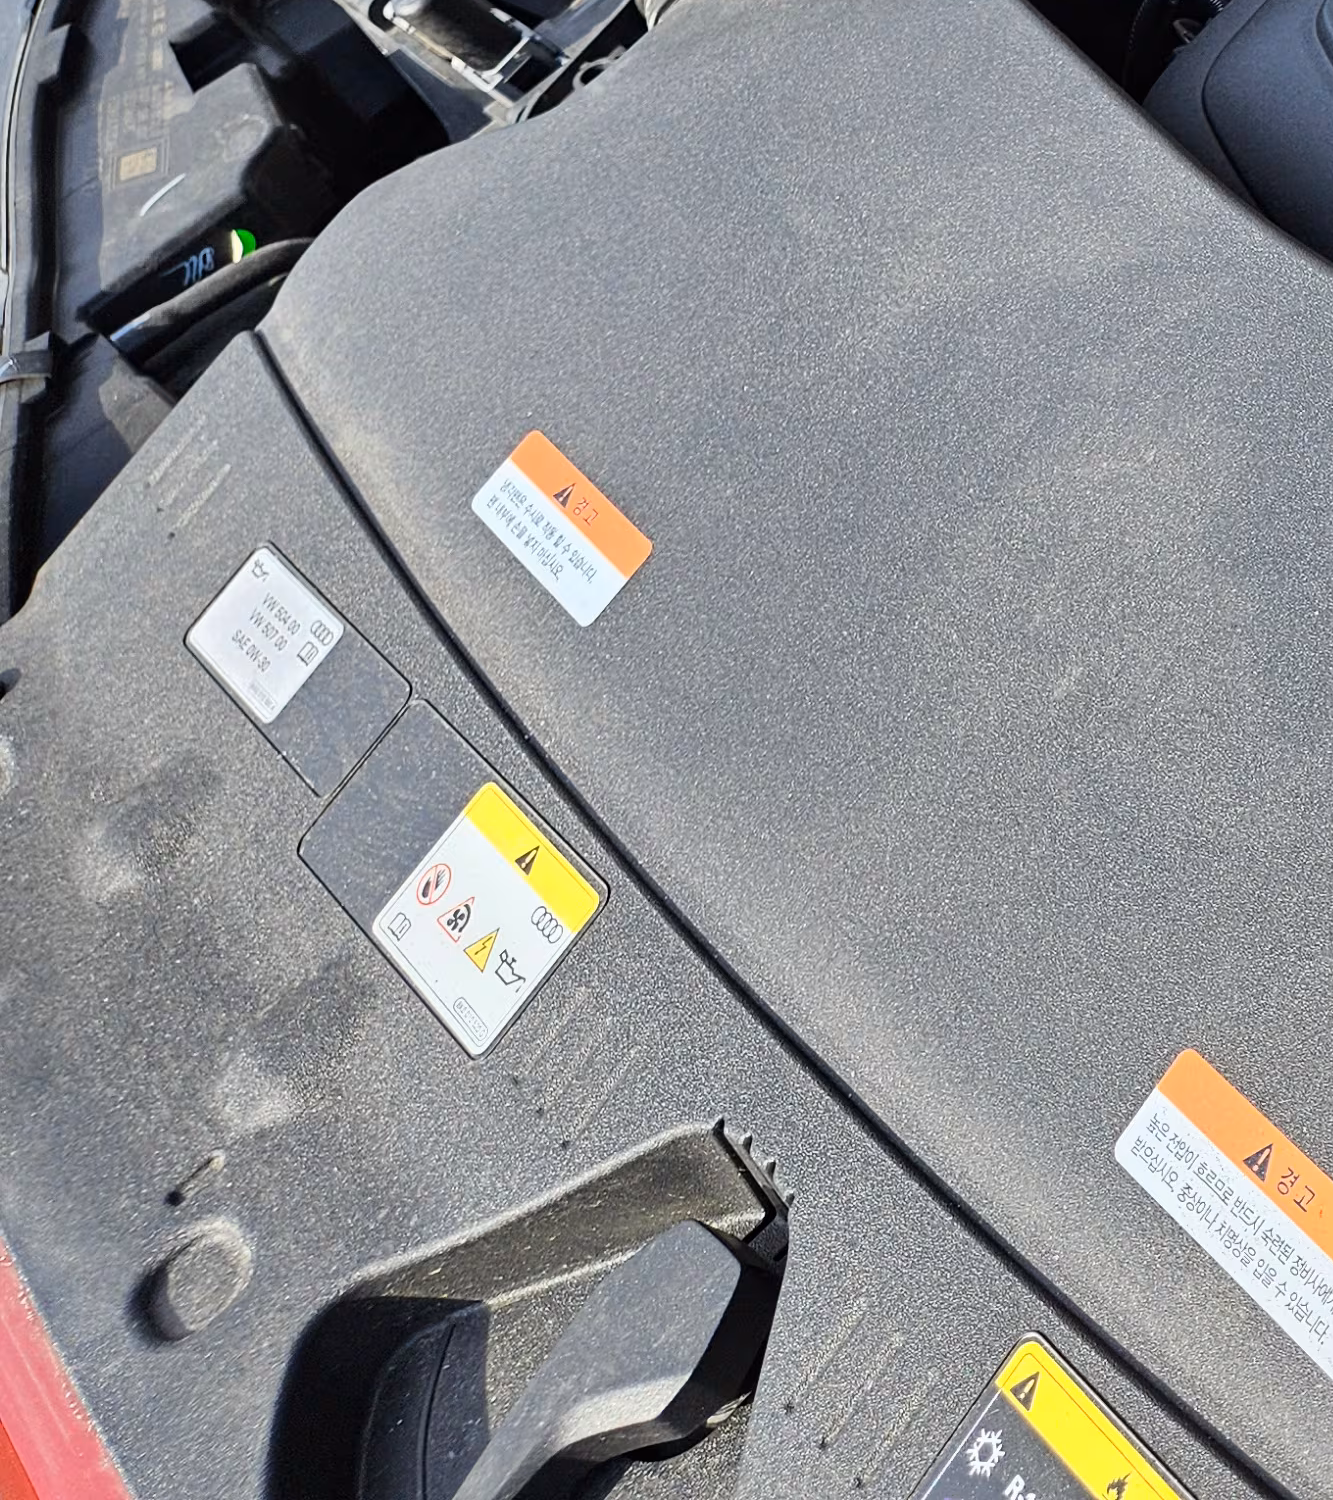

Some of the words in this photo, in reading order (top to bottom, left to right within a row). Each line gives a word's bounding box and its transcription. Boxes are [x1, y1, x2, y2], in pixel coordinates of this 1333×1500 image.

[571, 496, 600, 527] 경고
[559, 540, 573, 556] 수
[567, 548, 599, 583] 있습니다.
[248, 608, 266, 628] VW
[261, 621, 278, 641] 507
[274, 634, 288, 651] 00
[261, 592, 279, 612] VW
[274, 605, 291, 625] 504
[286, 619, 301, 635] 00
[231, 628, 250, 650] SAE
[245, 643, 271, 672] 0W-30
[1145, 1112, 1172, 1143] 높은
[1164, 1131, 1199, 1171] 전압이
[1192, 1158, 1236, 1206] 흐르므로
[1229, 1195, 1265, 1237] 반드시
[1258, 1224, 1294, 1265] 숙련된
[1274, 1165, 1319, 1216] 경고
[1129, 1135, 1182, 1193] 받으십시오.
[1175, 1181, 1220, 1231] 중상이나
[1212, 1218, 1257, 1269] 치명상을
[1251, 1256, 1278, 1290] 입을
[1271, 1276, 1290, 1301] 수
[1283, 1289, 1333, 1345] 있습니다.
